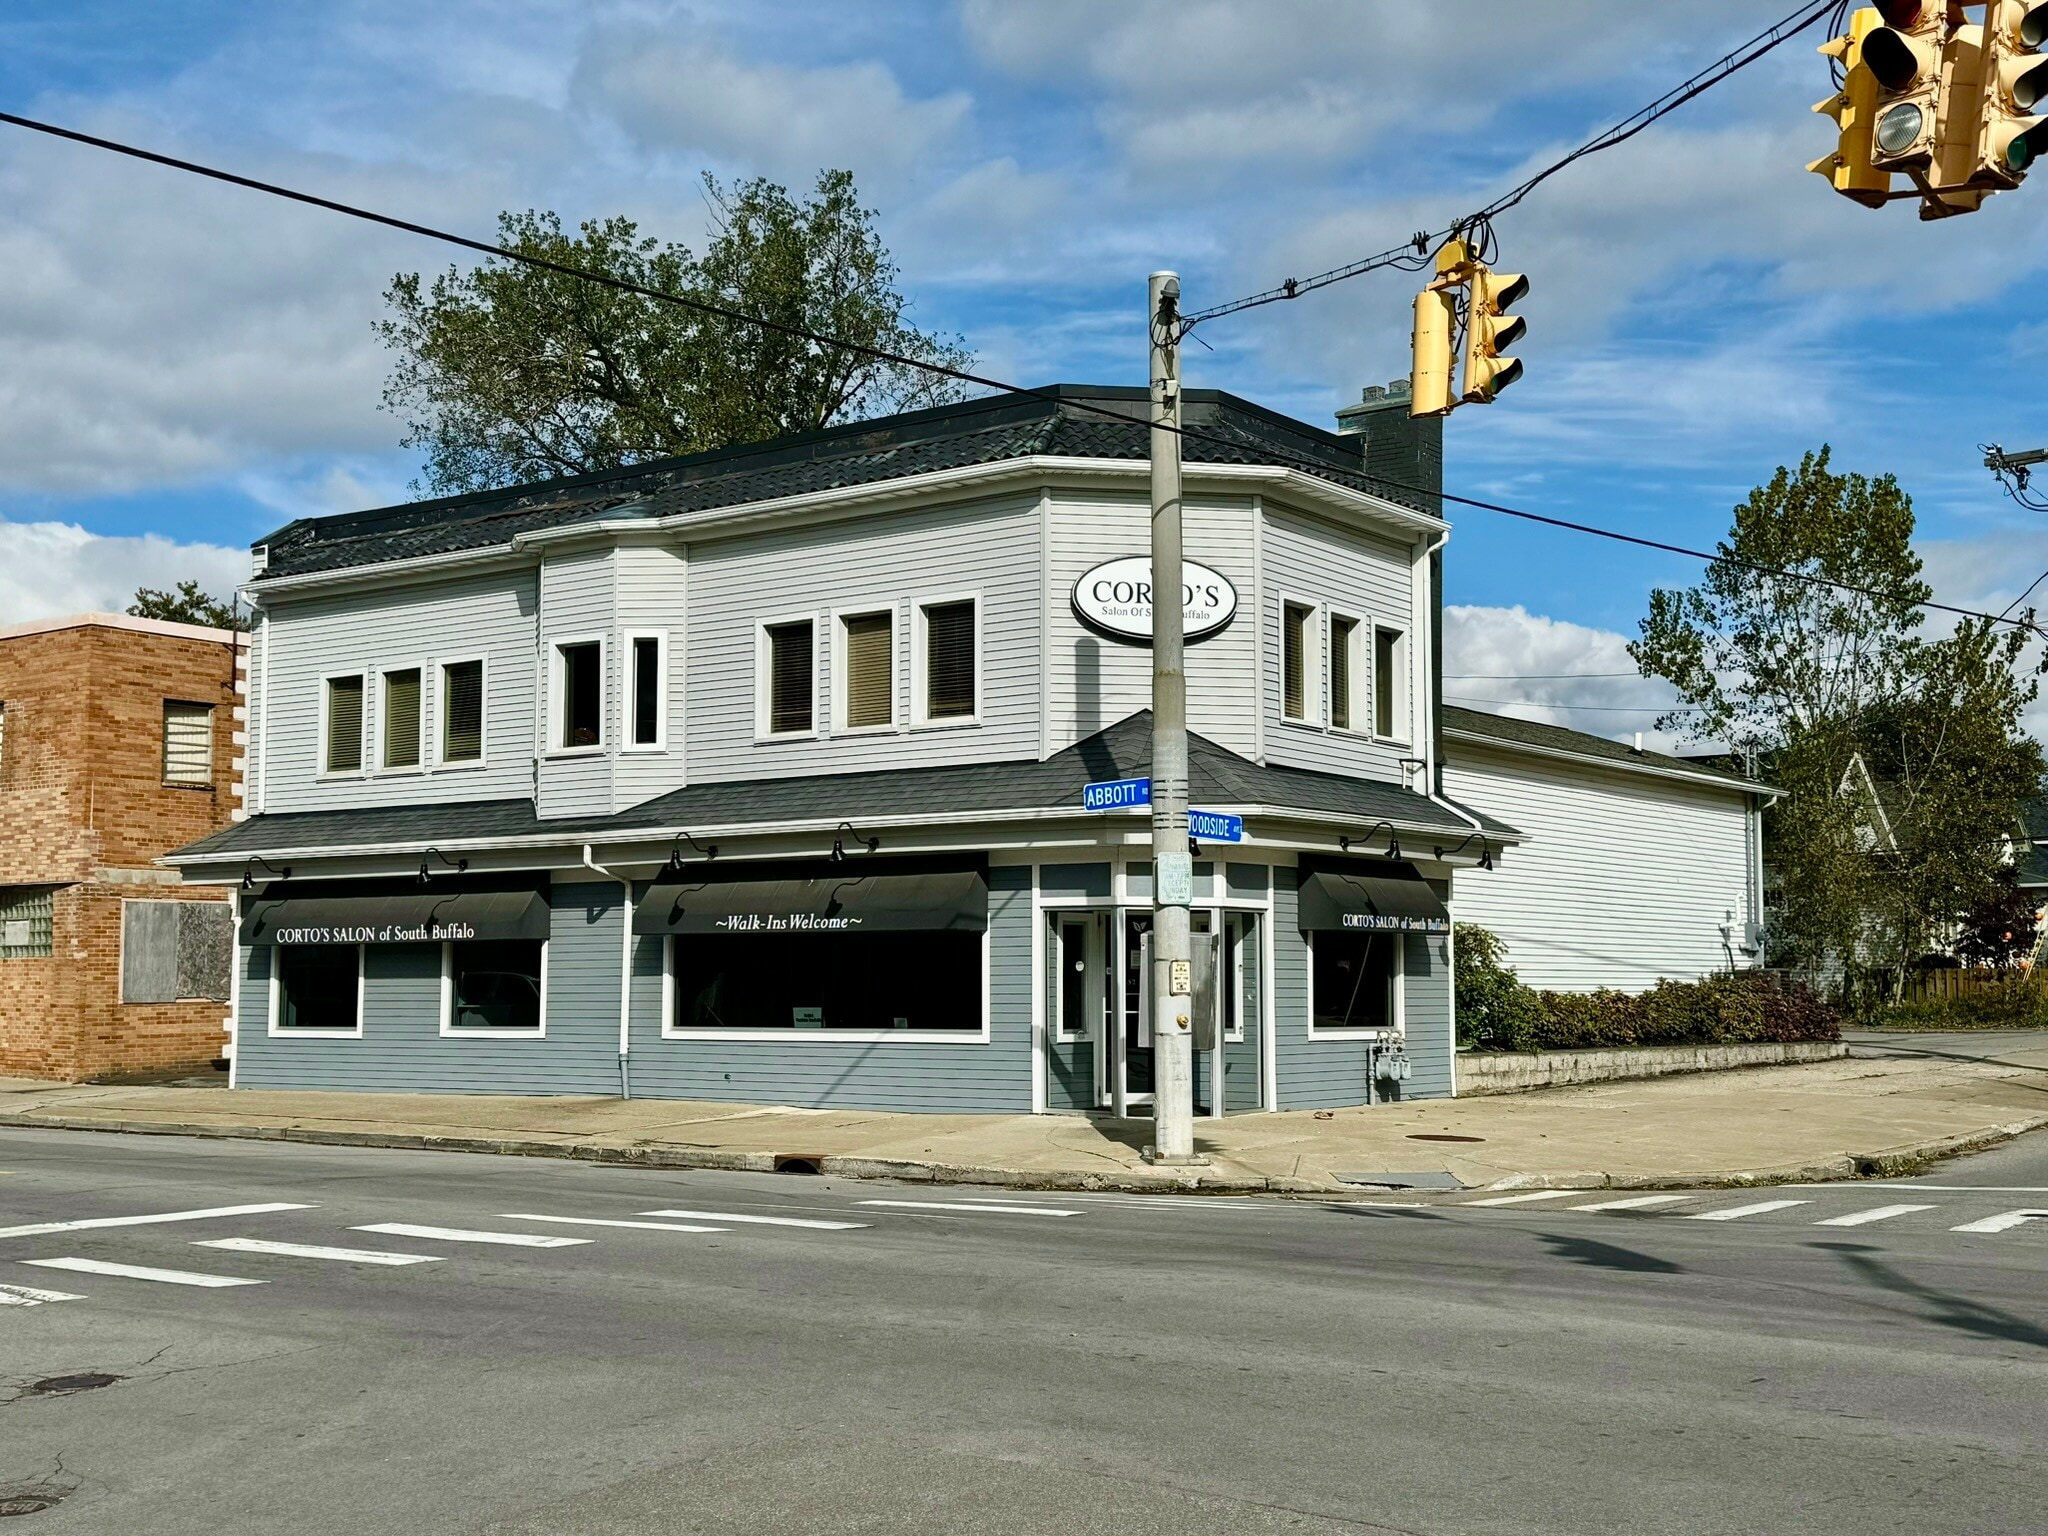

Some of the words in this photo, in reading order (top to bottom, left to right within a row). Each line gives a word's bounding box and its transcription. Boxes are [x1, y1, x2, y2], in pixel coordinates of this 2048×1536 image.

[1093, 580, 1219, 607] CORO'S
[1101, 606, 1128, 616] Salon
[1130, 607, 1144, 617] Of
[1181, 610, 1210, 619] uffalo
[1086, 784, 1136, 807] ABBOTT
[276, 927, 330, 943] CORTO'S
[333, 927, 375, 942] SALON
[379, 925, 392, 941] of
[394, 923, 428, 941] South
[432, 922, 475, 940] Buffalo
[1342, 913, 1375, 928] CORTO'S
[1376, 915, 1399, 929] SALON
[1400, 916, 1408, 930] of
[1408, 917, 1426, 931] South
[1427, 918, 1449, 932] Buffalo
